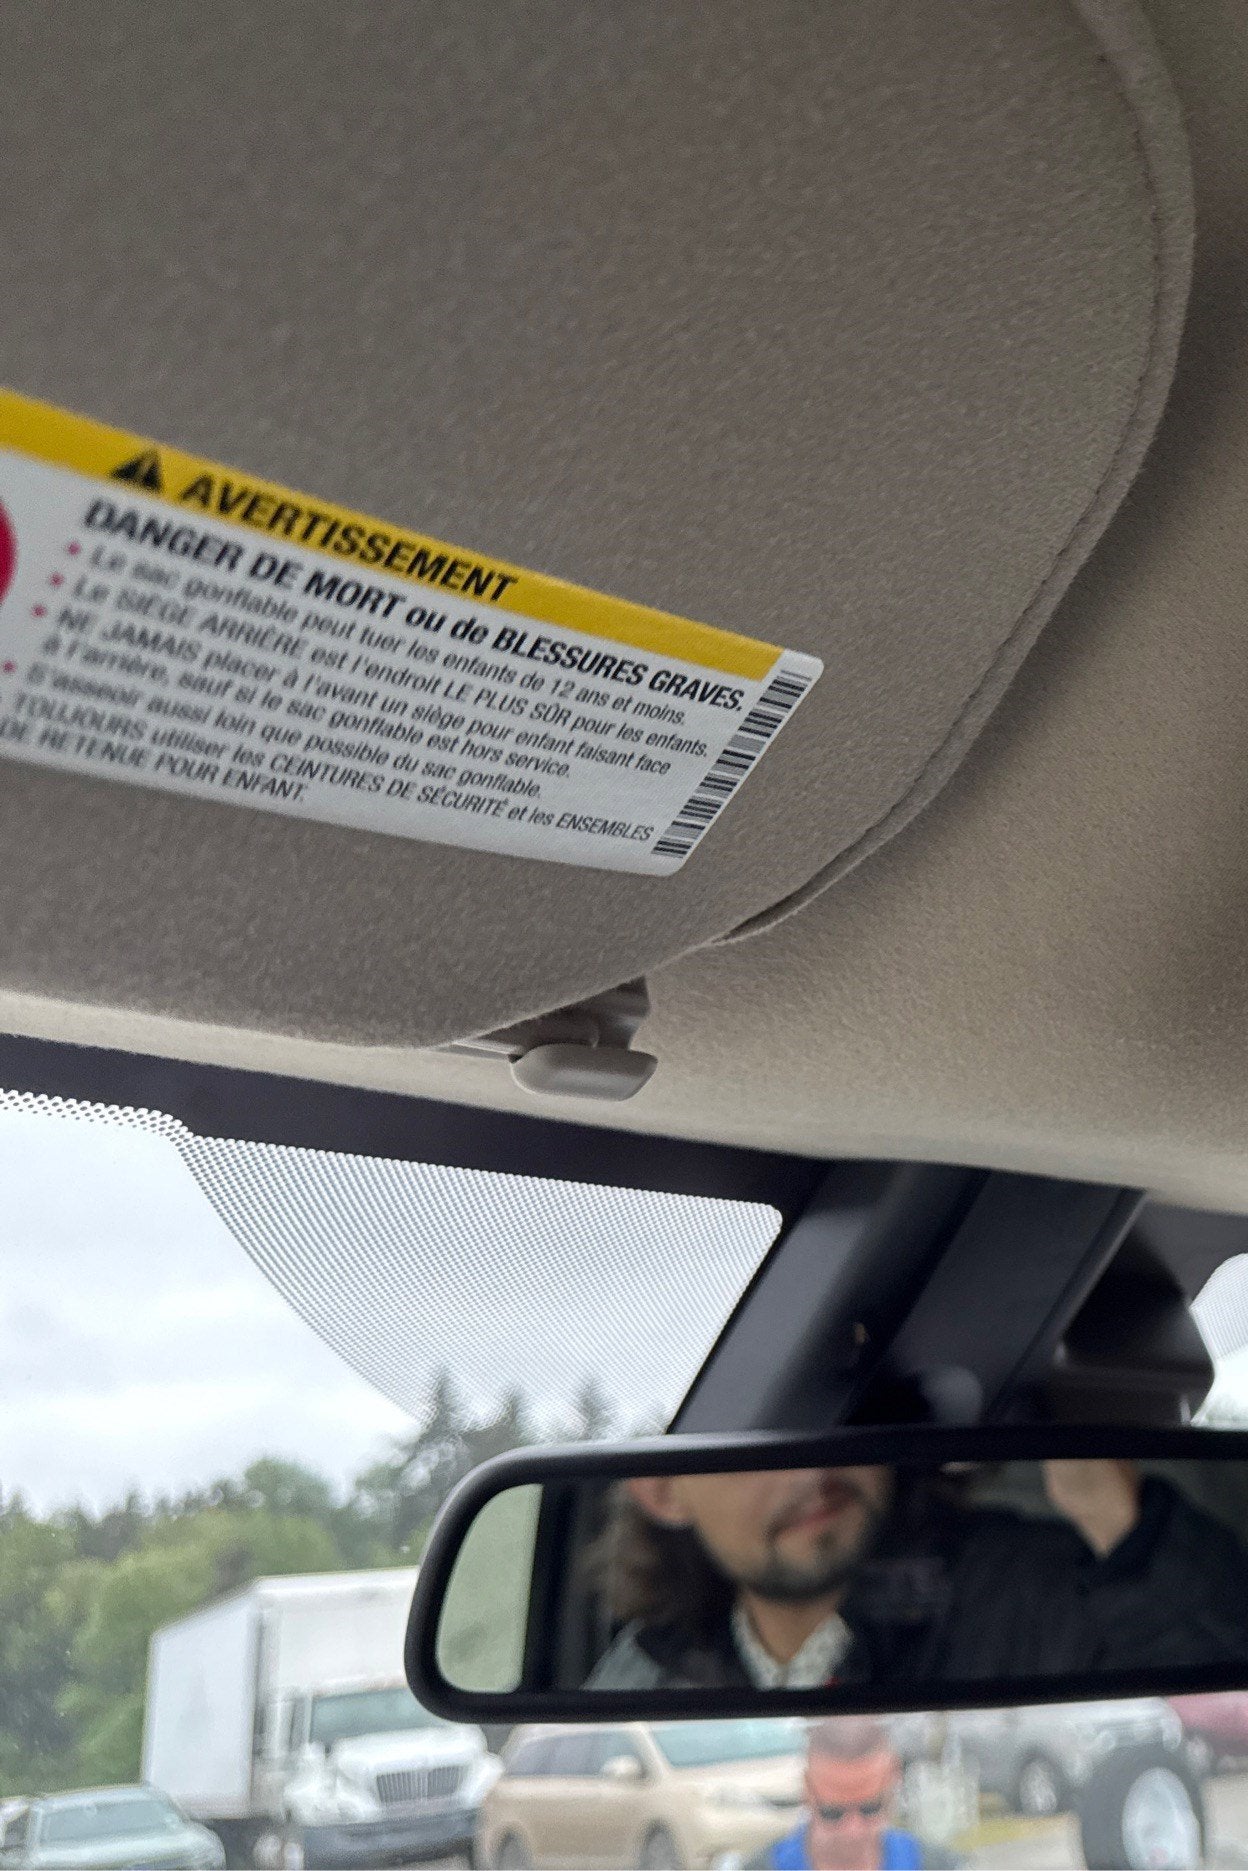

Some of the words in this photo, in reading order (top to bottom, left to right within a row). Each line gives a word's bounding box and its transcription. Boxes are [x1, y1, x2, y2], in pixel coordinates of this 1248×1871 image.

[84, 500, 243, 570] DANGER
[248, 551, 302, 590] DE
[303, 570, 404, 618] MORT
[404, 606, 446, 632] ou
[449, 617, 489, 644] de
[491, 627, 648, 685] BLESSURES
[647, 669, 744, 711] GRAVES.
[180, 475, 518, 602] AVERTISSEMENT
[71, 576, 109, 603] Le
[198, 612, 311, 658] ARRIÈRE
[309, 647, 348, 670] est
[350, 655, 442, 694] l'endroit
[441, 680, 473, 703] LE
[472, 687, 529, 716] PLUS
[528, 702, 572, 727] SÛR
[568, 715, 616, 735] pour
[615, 721, 644, 743] les
[644, 732, 709, 758] enfants.
[89, 546, 126, 572] Le
[182, 578, 298, 622] gonflable
[299, 612, 357, 640] peut
[358, 625, 403, 653] tuer
[405, 638, 440, 663] les
[441, 653, 517, 684] enfants
[518, 671, 545, 691] de
[549, 677, 576, 698] 12
[574, 687, 610, 706] ans
[610, 695, 633, 713] et
[631, 700, 687, 726] moins.
[102, 623, 200, 661] JAMAIS
[201, 650, 277, 682] placer
[281, 667, 299, 689] à
[302, 673, 378, 708] l'avant
[379, 696, 409, 716] un
[410, 704, 466, 730] siège
[464, 718, 512, 740] pour
[514, 731, 575, 755] enfant
[574, 740, 635, 768] faisant
[634, 753, 672, 775] face
[14, 692, 146, 739] TOUJOURS
[149, 729, 227, 758] utiliser
[230, 743, 266, 767] les
[268, 753, 385, 792] CEINTURES
[385, 778, 415, 801] DE
[415, 784, 509, 817] SÉCURITÉ
[506, 805, 528, 821] et
[526, 806, 555, 826] les
[554, 811, 654, 841] ENSEMBLES
[38, 728, 145, 767] RETENUE
[153, 752, 220, 783] POUR
[145, 696, 211, 724] aussi
[212, 709, 256, 735] loin
[259, 724, 302, 745] que
[302, 734, 390, 765] possible
[391, 752, 420, 772] du
[420, 761, 457, 779] sac
[456, 769, 542, 799] gonflable.
[176, 671, 233, 697] sauf
[233, 685, 258, 704] si
[259, 689, 283, 710] le
[285, 699, 326, 720] sac
[327, 710, 424, 744] gonflable
[425, 734, 460, 753] est
[458, 737, 504, 762] hors
[503, 751, 571, 778] service.
